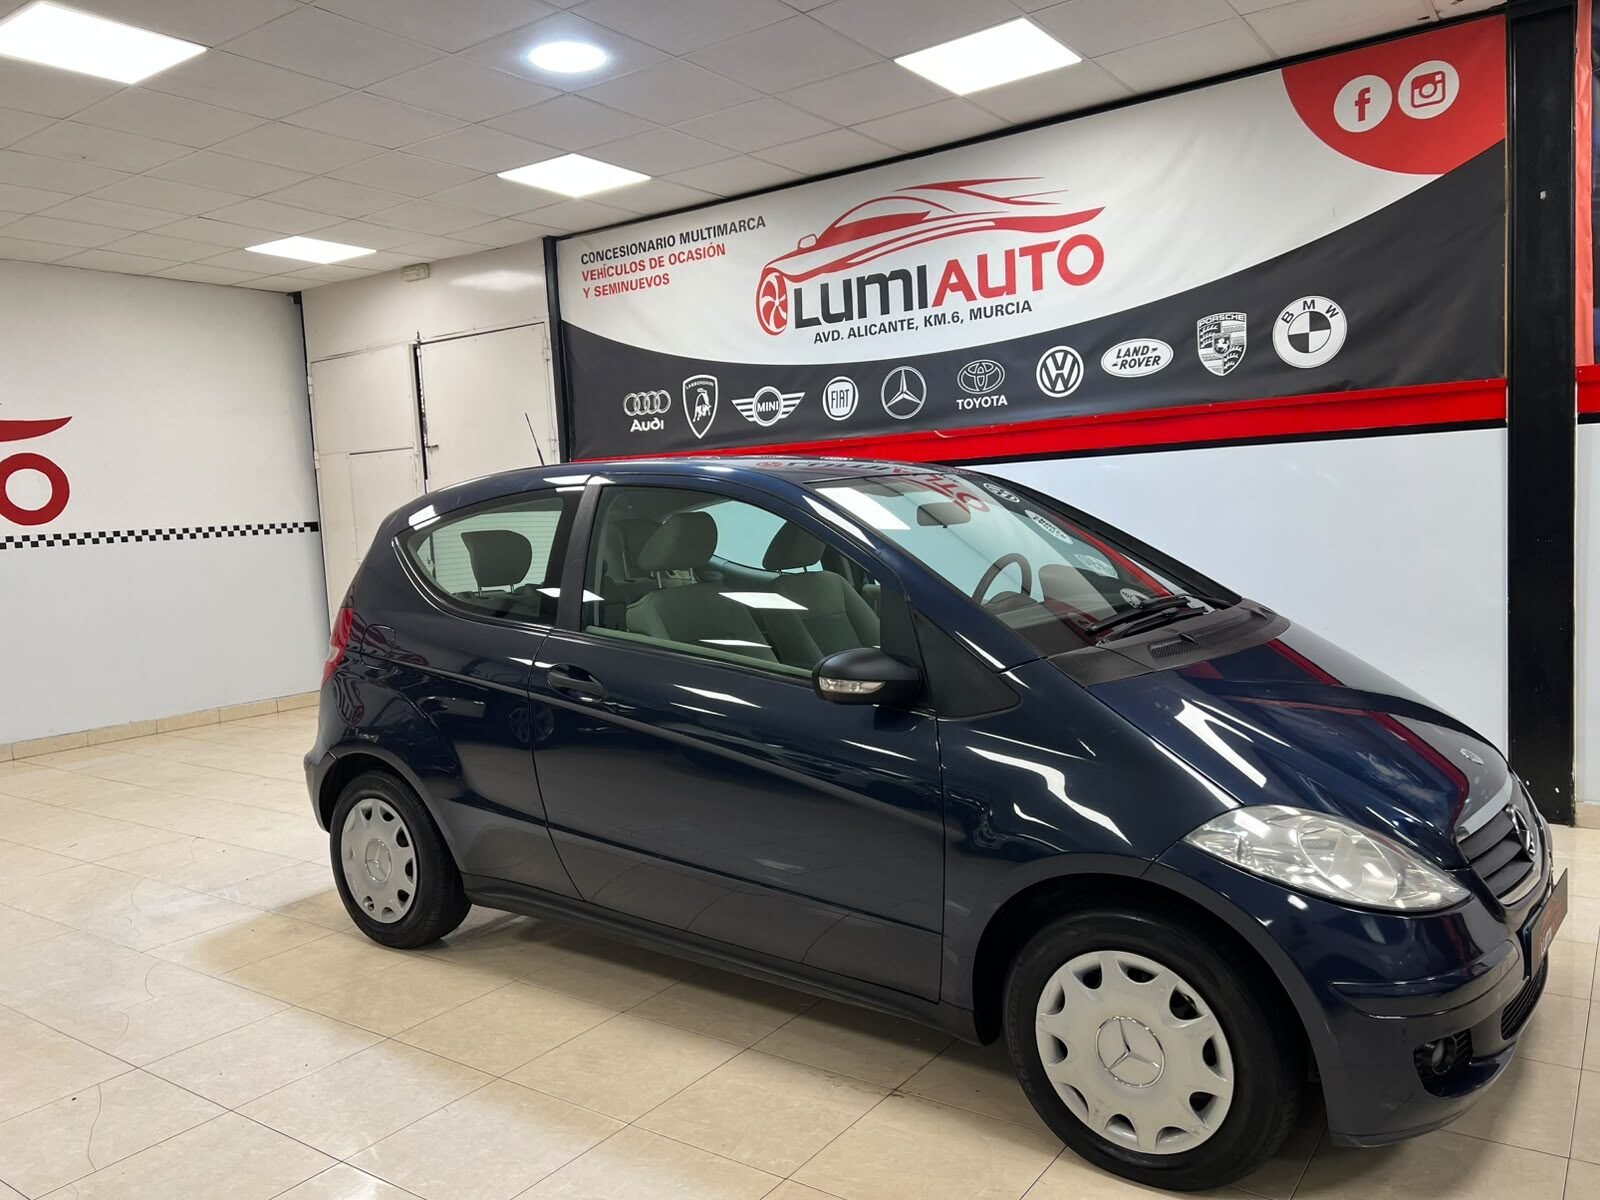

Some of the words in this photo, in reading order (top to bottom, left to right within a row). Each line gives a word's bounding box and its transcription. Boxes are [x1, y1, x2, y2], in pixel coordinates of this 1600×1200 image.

[581, 235, 676, 265] CONCESIONARIO
[679, 215, 766, 247] MULTIMARCA
[582, 260, 646, 282] VEHÍCULOS
[650, 256, 665, 270] DE
[668, 241, 726, 265] OCASIÓN
[583, 287, 591, 299] Y
[594, 273, 670, 297] SEMINUEVOS
[813, 327, 844, 344] AVD.
[847, 318, 919, 339] ALICANTE,
[924, 310, 965, 328] KM.6,
[969, 299, 1033, 321] MURCIA
[1199, 313, 1244, 326] PORSCHE
[757, 400, 779, 413] MINI
[830, 388, 850, 409] FIAT
[956, 394, 1008, 410] TOYOTA
[630, 418, 664, 432] Audi
